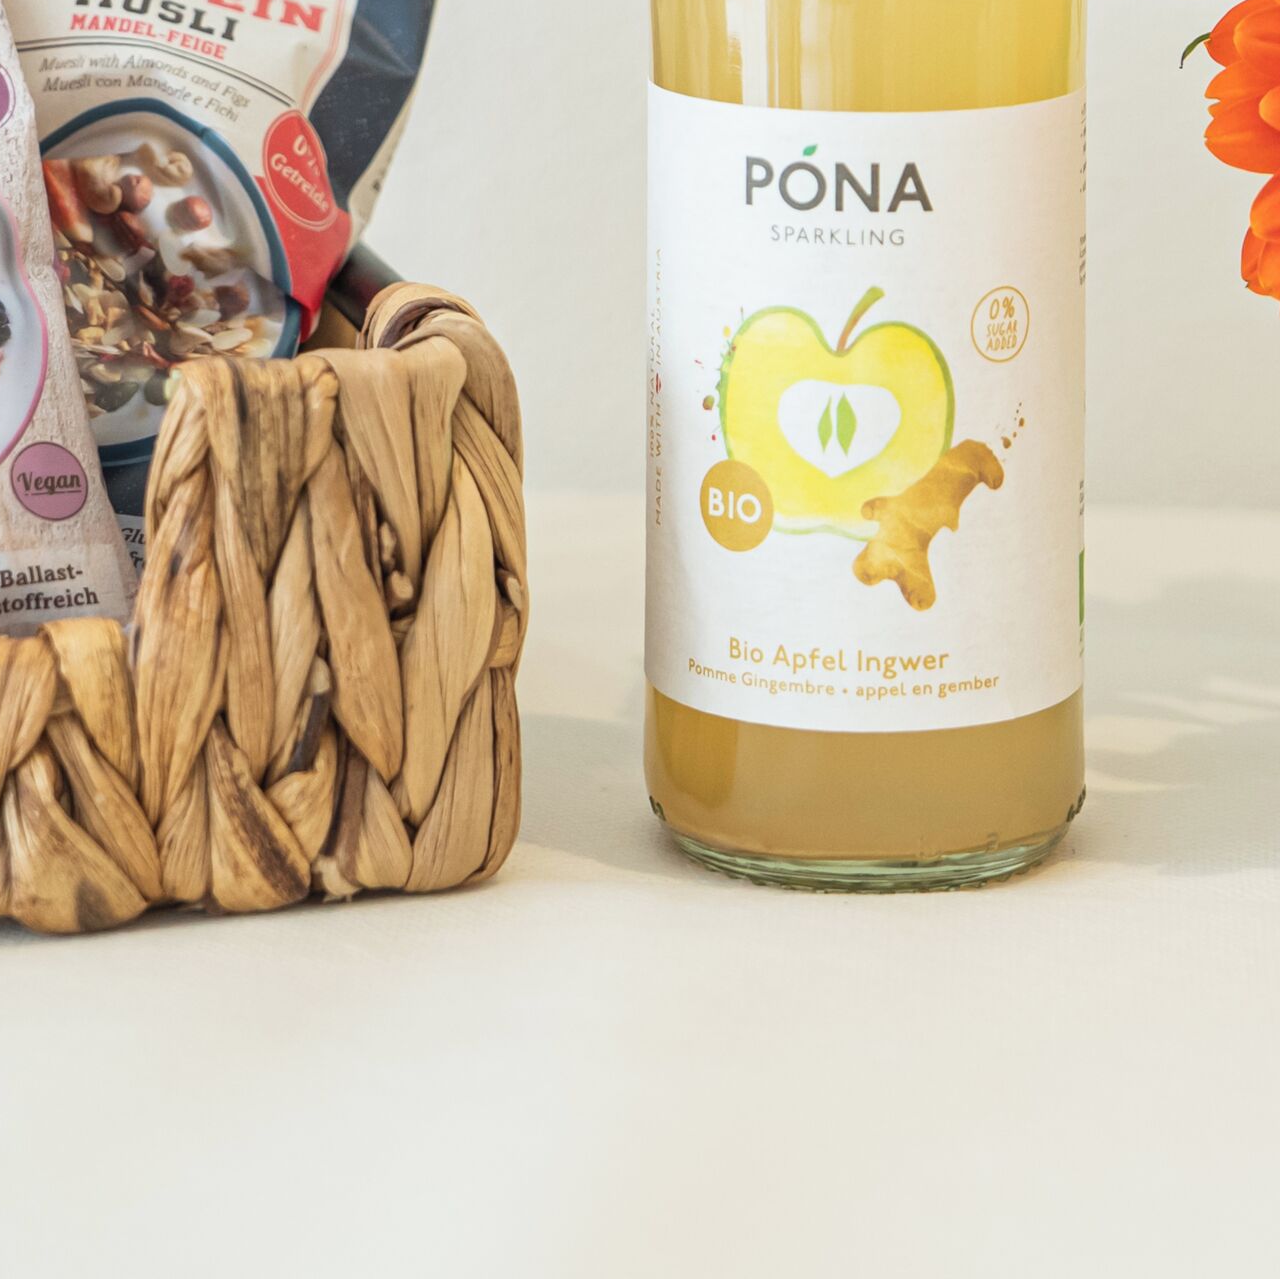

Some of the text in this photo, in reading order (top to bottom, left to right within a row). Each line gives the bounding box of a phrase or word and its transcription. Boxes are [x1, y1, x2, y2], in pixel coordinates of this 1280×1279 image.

[70, 13, 229, 61] MANDEL-FEIGE
[88, 54, 121, 69] with
[123, 54, 190, 80] Almonds
[191, 72, 220, 93] and
[94, 75, 122, 88] con
[270, 152, 331, 213] Getreide
[770, 224, 907, 247] SPARKLING
[988, 296, 1016, 320] 0%
[986, 319, 1018, 338] SUGAR
[986, 334, 1018, 352] ADDED
[16, 467, 85, 496] Vegan
[707, 486, 763, 524] BIO
[728, 636, 950, 680] Bio Apfel Ingwer
[688, 657, 1001, 701] Pomme Gingembre appel en gember
